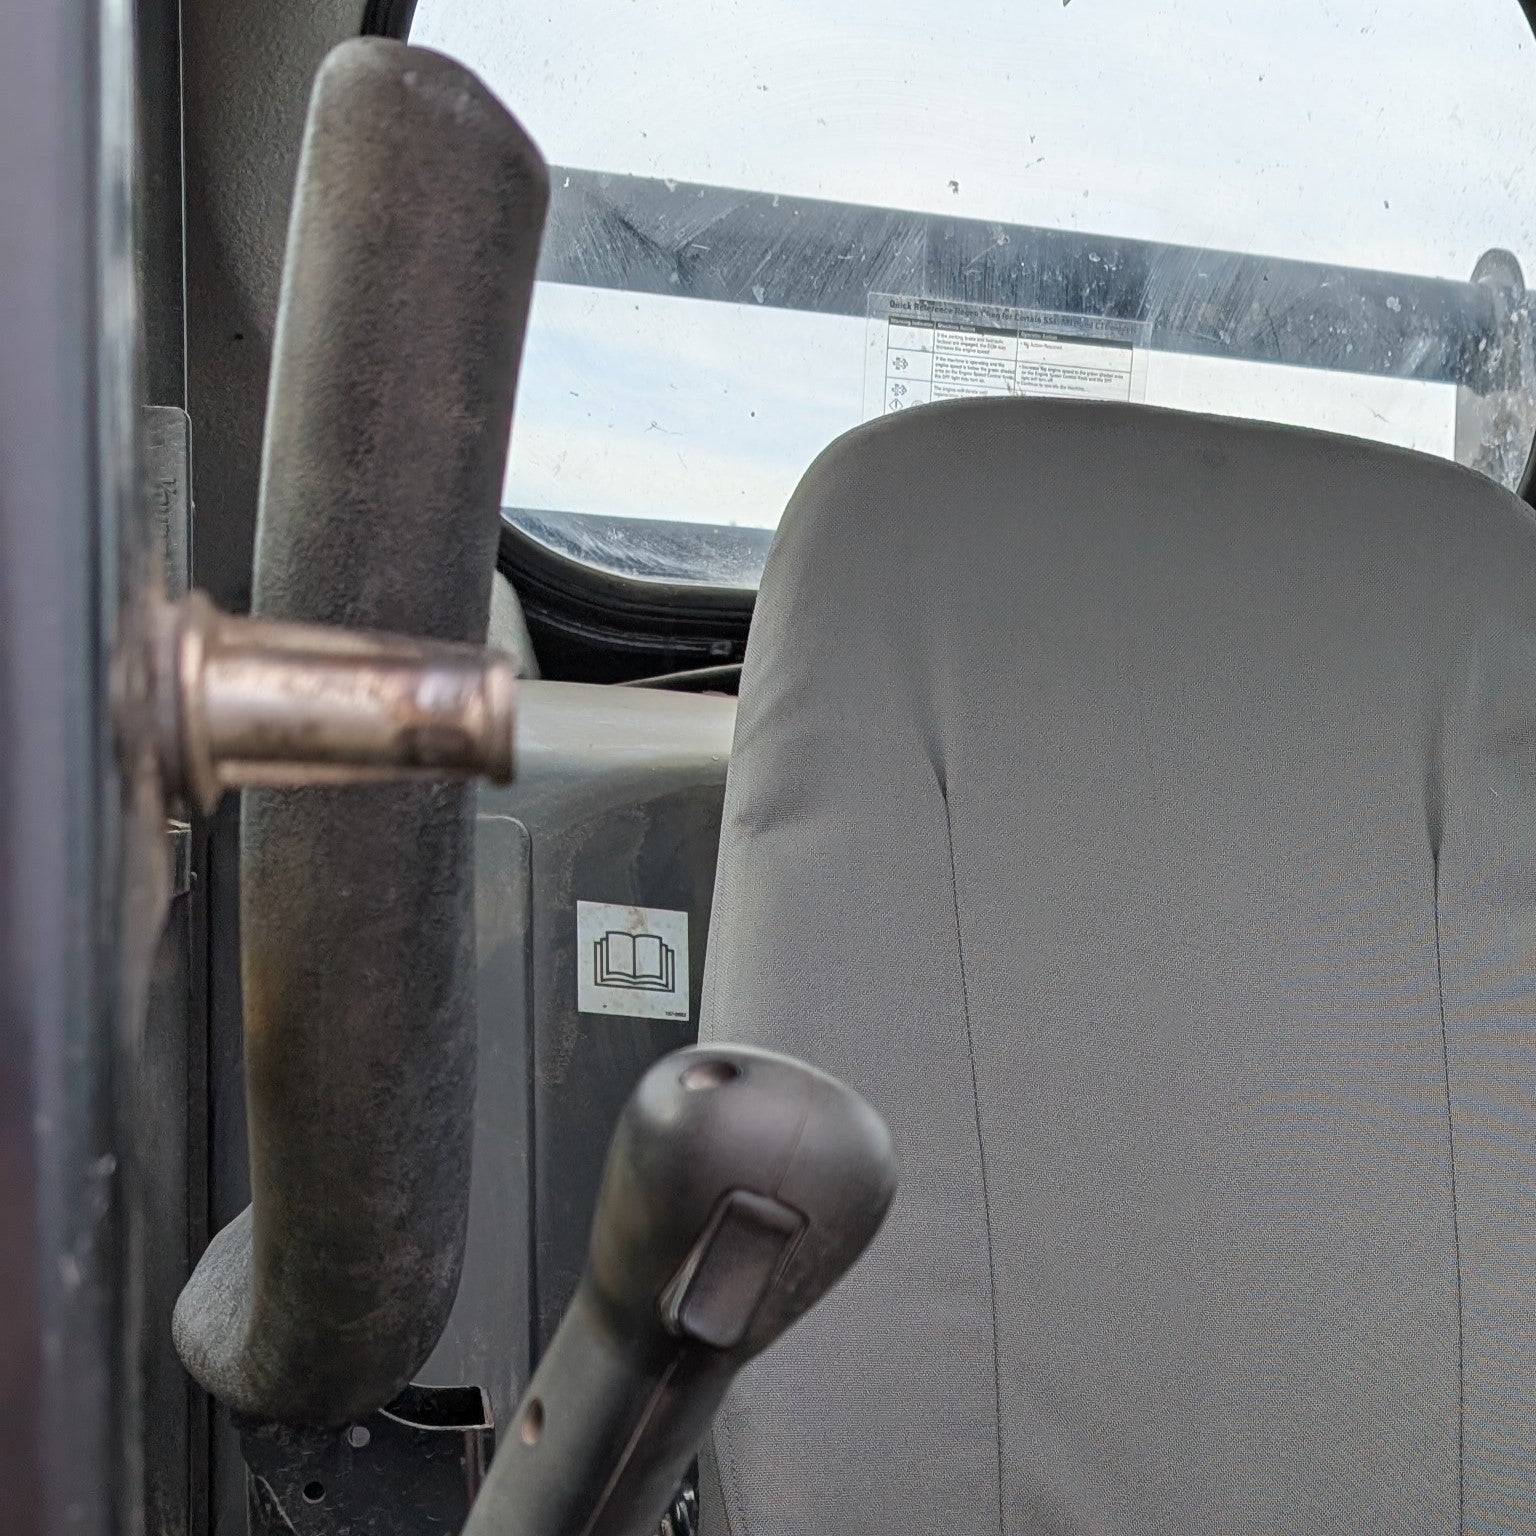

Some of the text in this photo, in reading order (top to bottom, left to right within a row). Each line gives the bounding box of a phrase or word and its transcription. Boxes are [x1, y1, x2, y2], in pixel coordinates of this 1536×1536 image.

[889, 300, 911, 310] Quick
[913, 302, 953, 315] Reference
[1001, 311, 1012, 320] for
